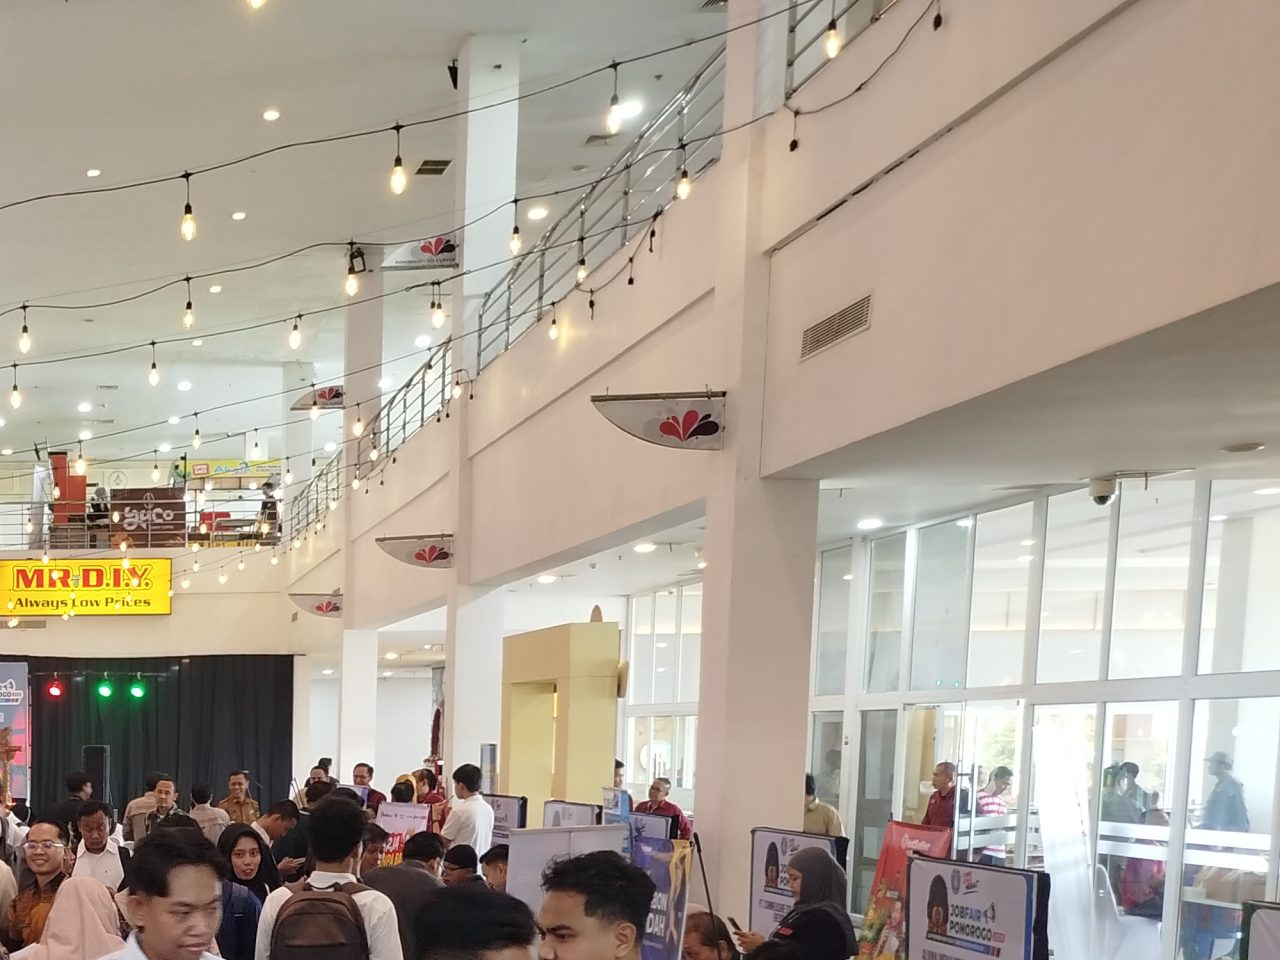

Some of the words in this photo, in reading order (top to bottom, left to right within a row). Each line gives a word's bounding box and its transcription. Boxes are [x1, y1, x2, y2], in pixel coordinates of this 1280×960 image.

[14, 597, 68, 610] Always
[72, 597, 103, 607] Low
[105, 597, 151, 608] Prices
[950, 904, 982, 922] JOBFAIR
[949, 920, 992, 942] PONOROGO
